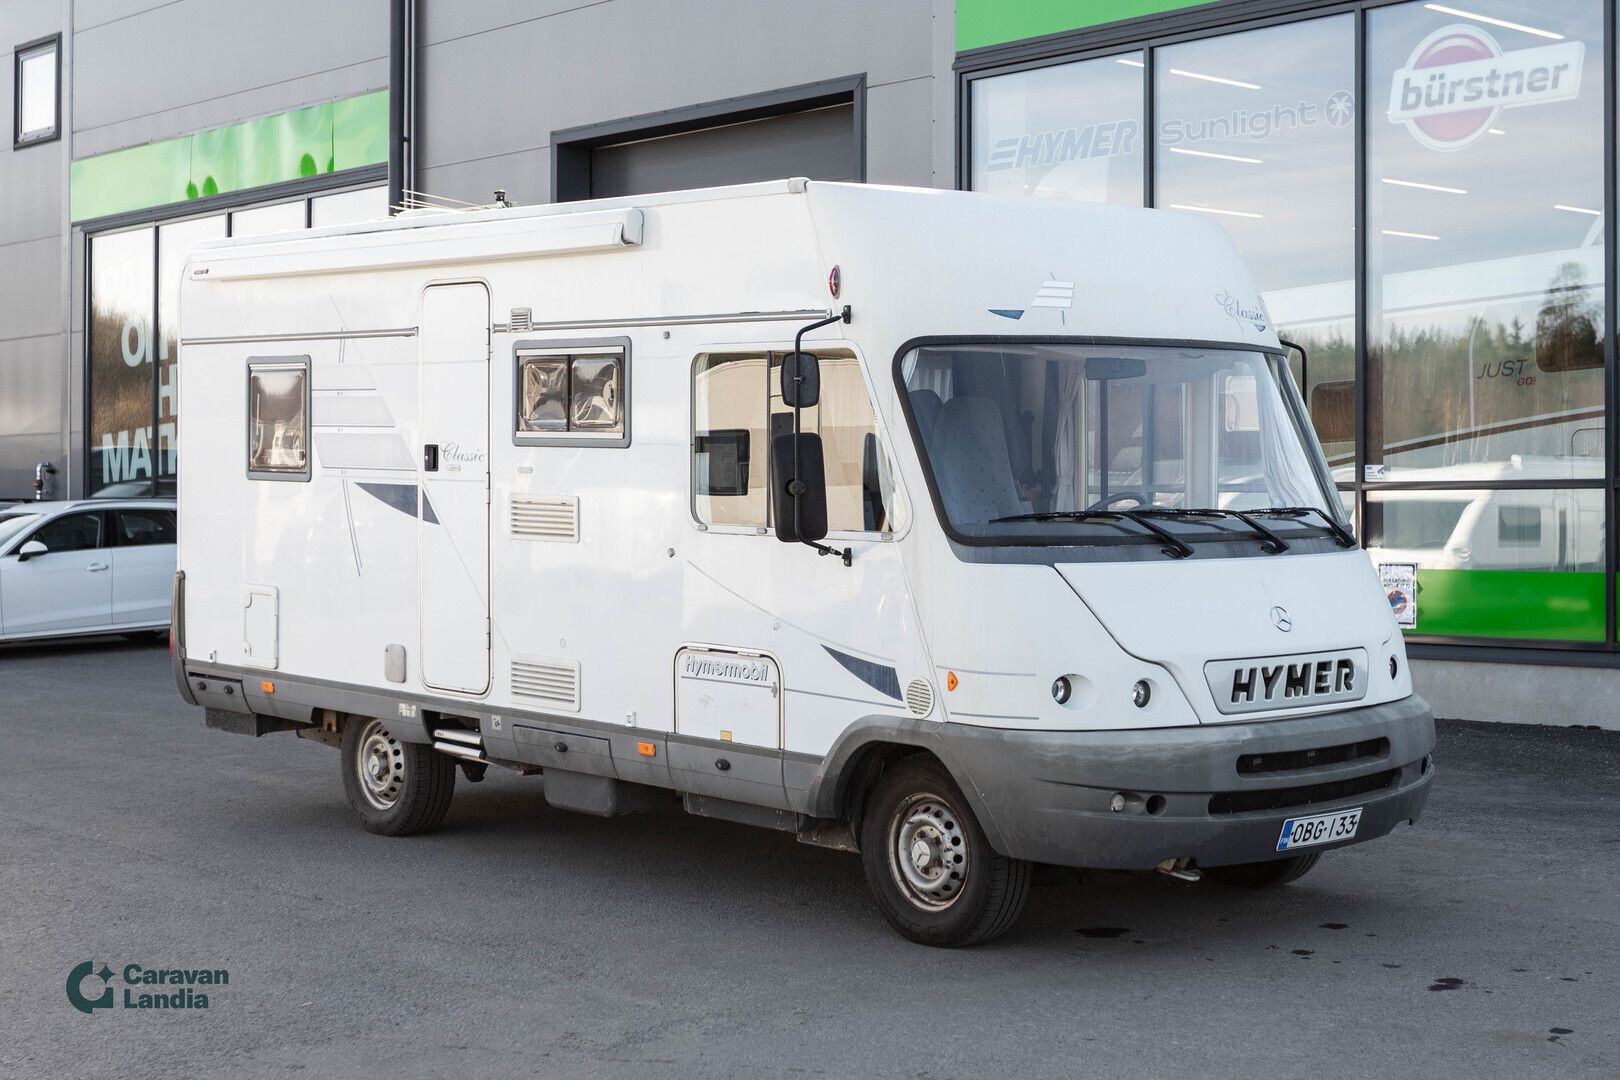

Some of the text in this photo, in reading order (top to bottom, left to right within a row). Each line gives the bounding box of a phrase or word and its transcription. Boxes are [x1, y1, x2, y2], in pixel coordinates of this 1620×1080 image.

[1400, 63, 1569, 111] bürstner
[1160, 101, 1318, 145] Sunlight
[1013, 119, 1138, 169] HYMER
[1213, 289, 1264, 321] Classic
[1477, 358, 1529, 379] JUST
[440, 442, 484, 461] Classic
[1230, 658, 1355, 703] HYMER
[1293, 814, 1357, 843] OBG-133
